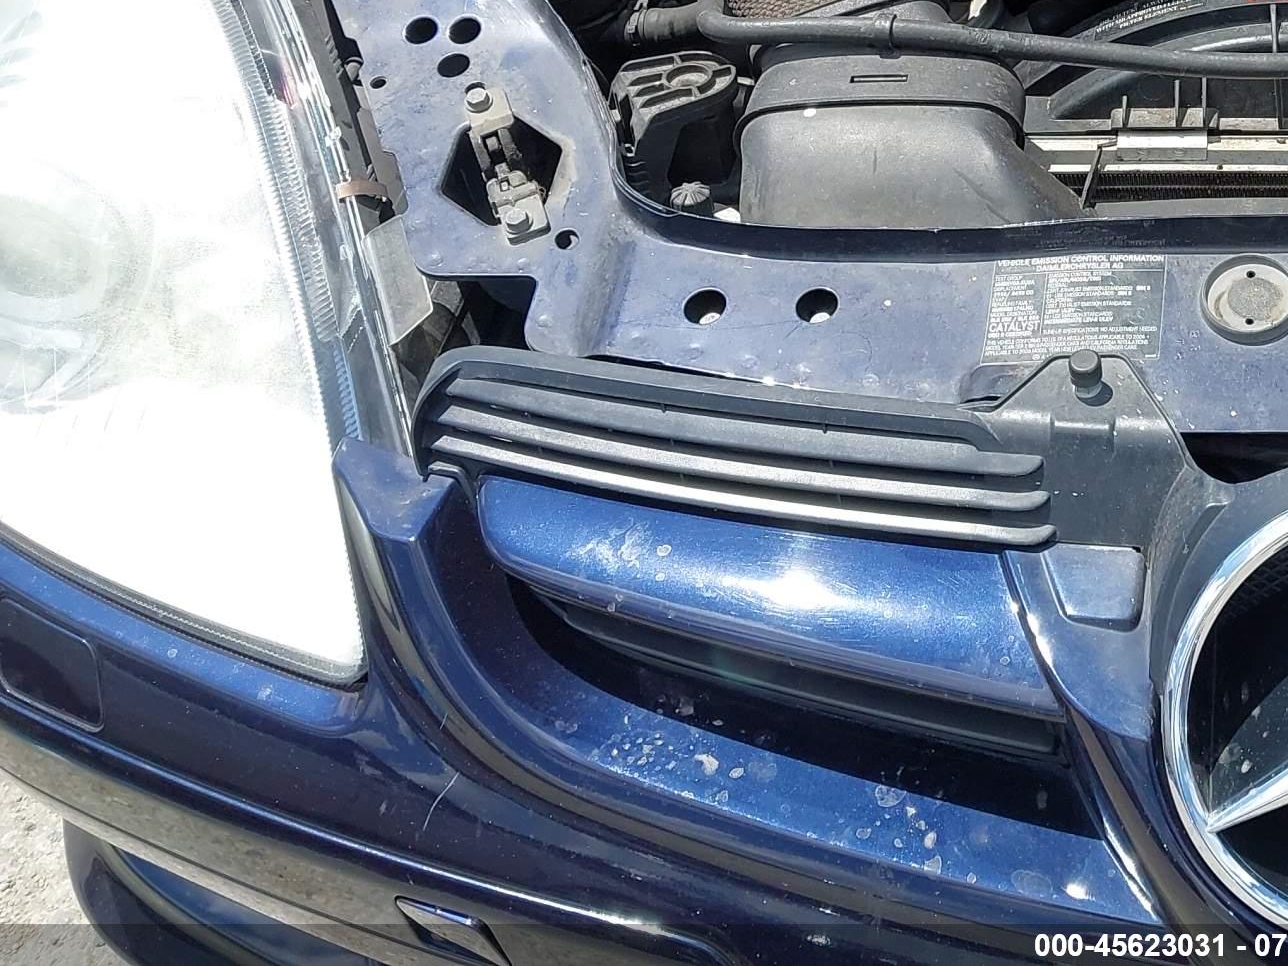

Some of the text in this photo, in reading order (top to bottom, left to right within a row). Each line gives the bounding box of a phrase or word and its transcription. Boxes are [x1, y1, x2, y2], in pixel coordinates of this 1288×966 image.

[1032, 256, 1070, 265] EMISSION
[1036, 263, 1111, 272] DAIMLERCHRYSLER
[989, 320, 1041, 332] CATALYST
